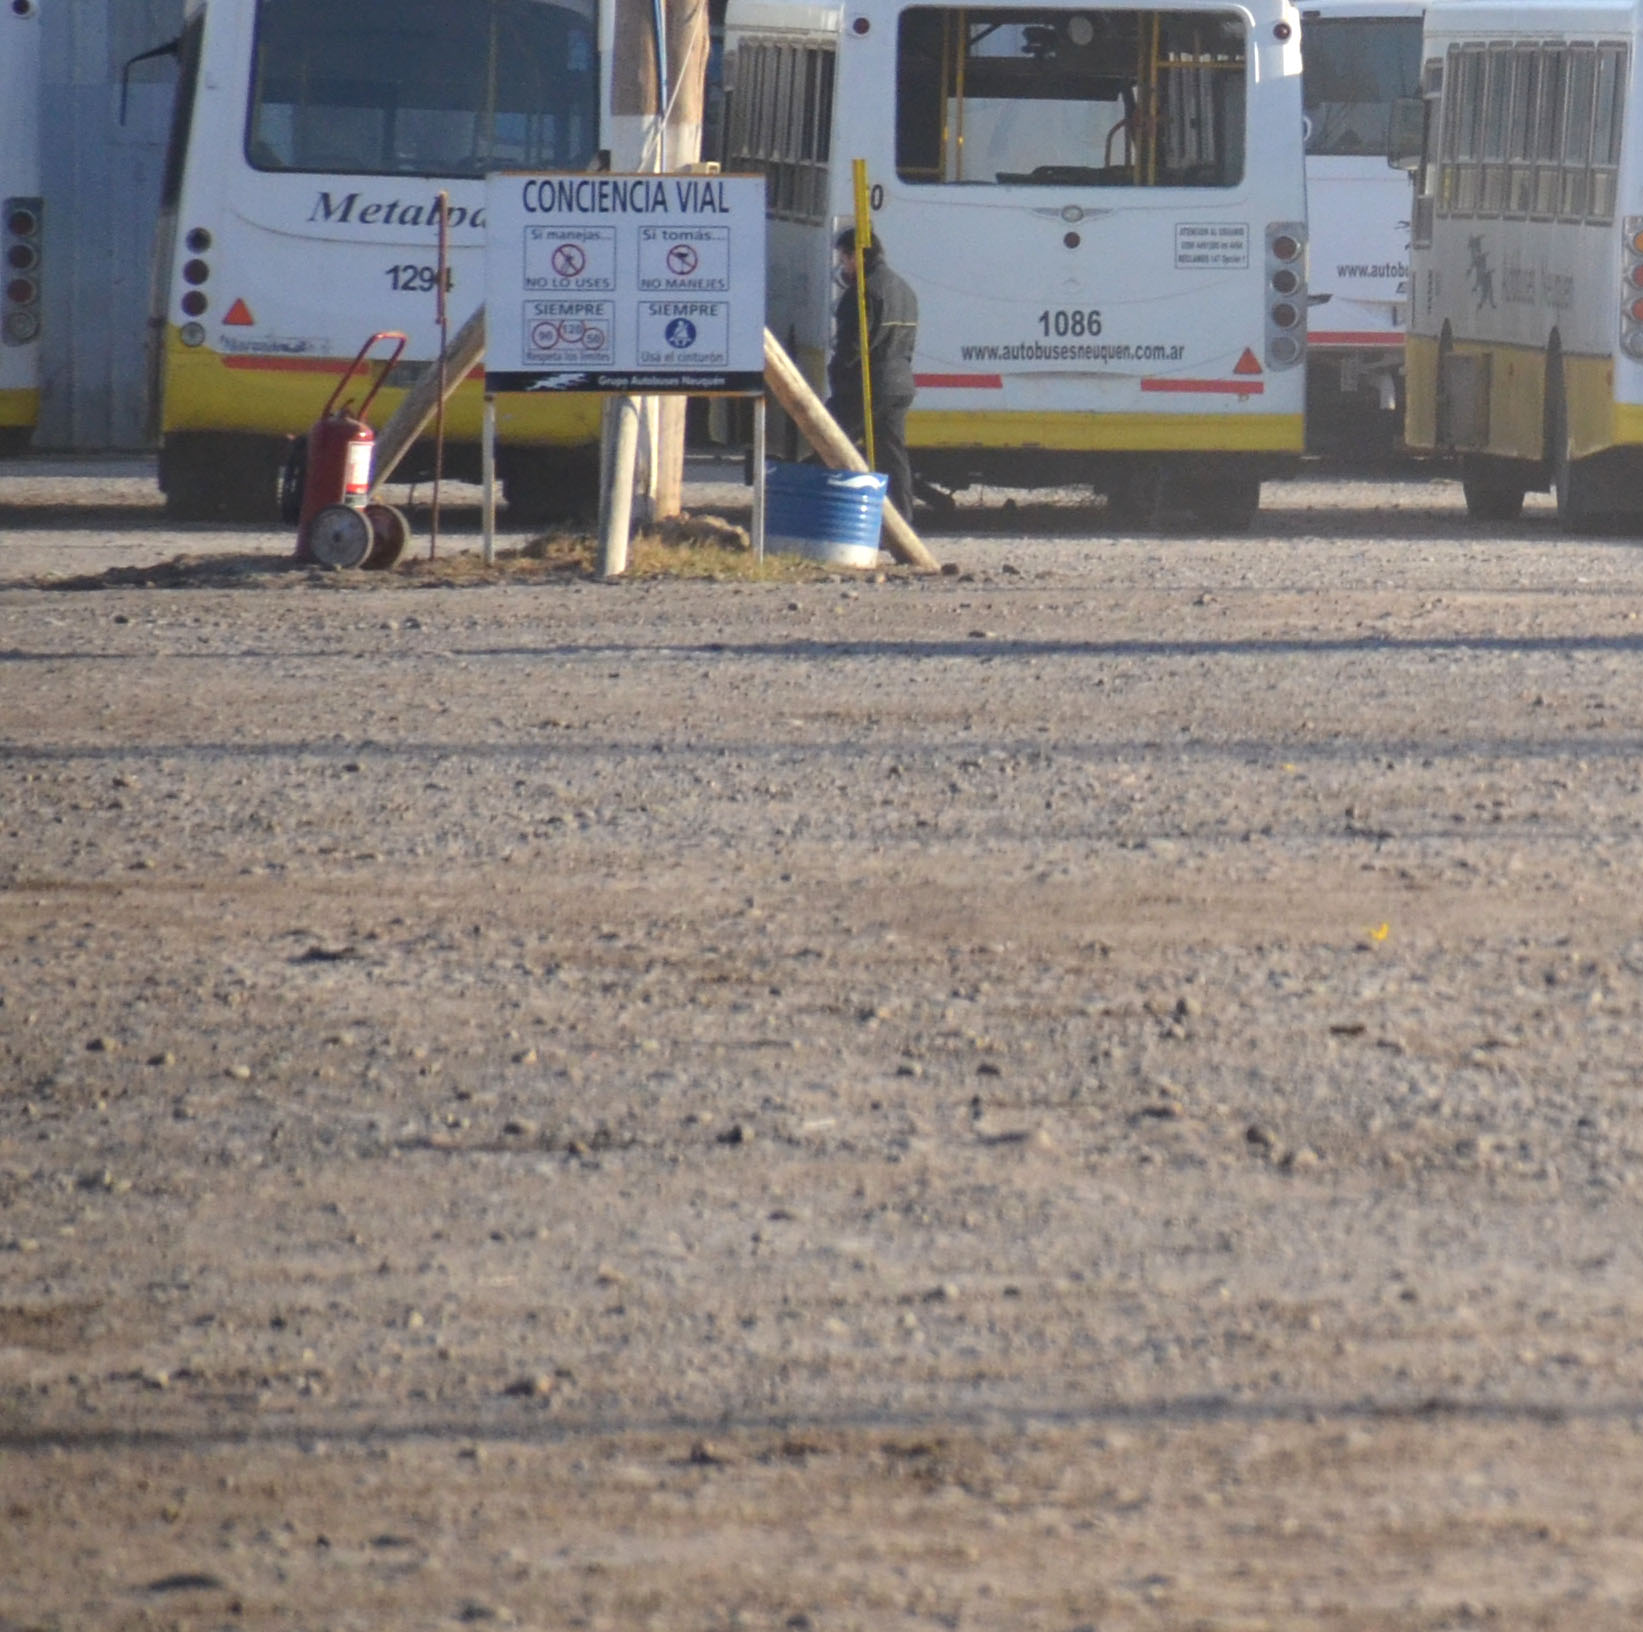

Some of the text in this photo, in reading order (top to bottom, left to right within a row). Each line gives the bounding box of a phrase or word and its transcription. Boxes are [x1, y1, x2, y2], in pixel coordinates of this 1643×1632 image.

[523, 180, 730, 214] CONCIENCIA VIAL
[530, 229, 544, 241] Si
[642, 228, 656, 241] Si
[526, 278, 610, 288] NO LO USES
[641, 279, 725, 289] NO MANEJES
[534, 303, 604, 316] SIEMPRE
[649, 304, 719, 316] SIEMPRE
[1038, 310, 1102, 337] 1086
[961, 341, 1185, 364] www.autobusesneuquen.com.ar
